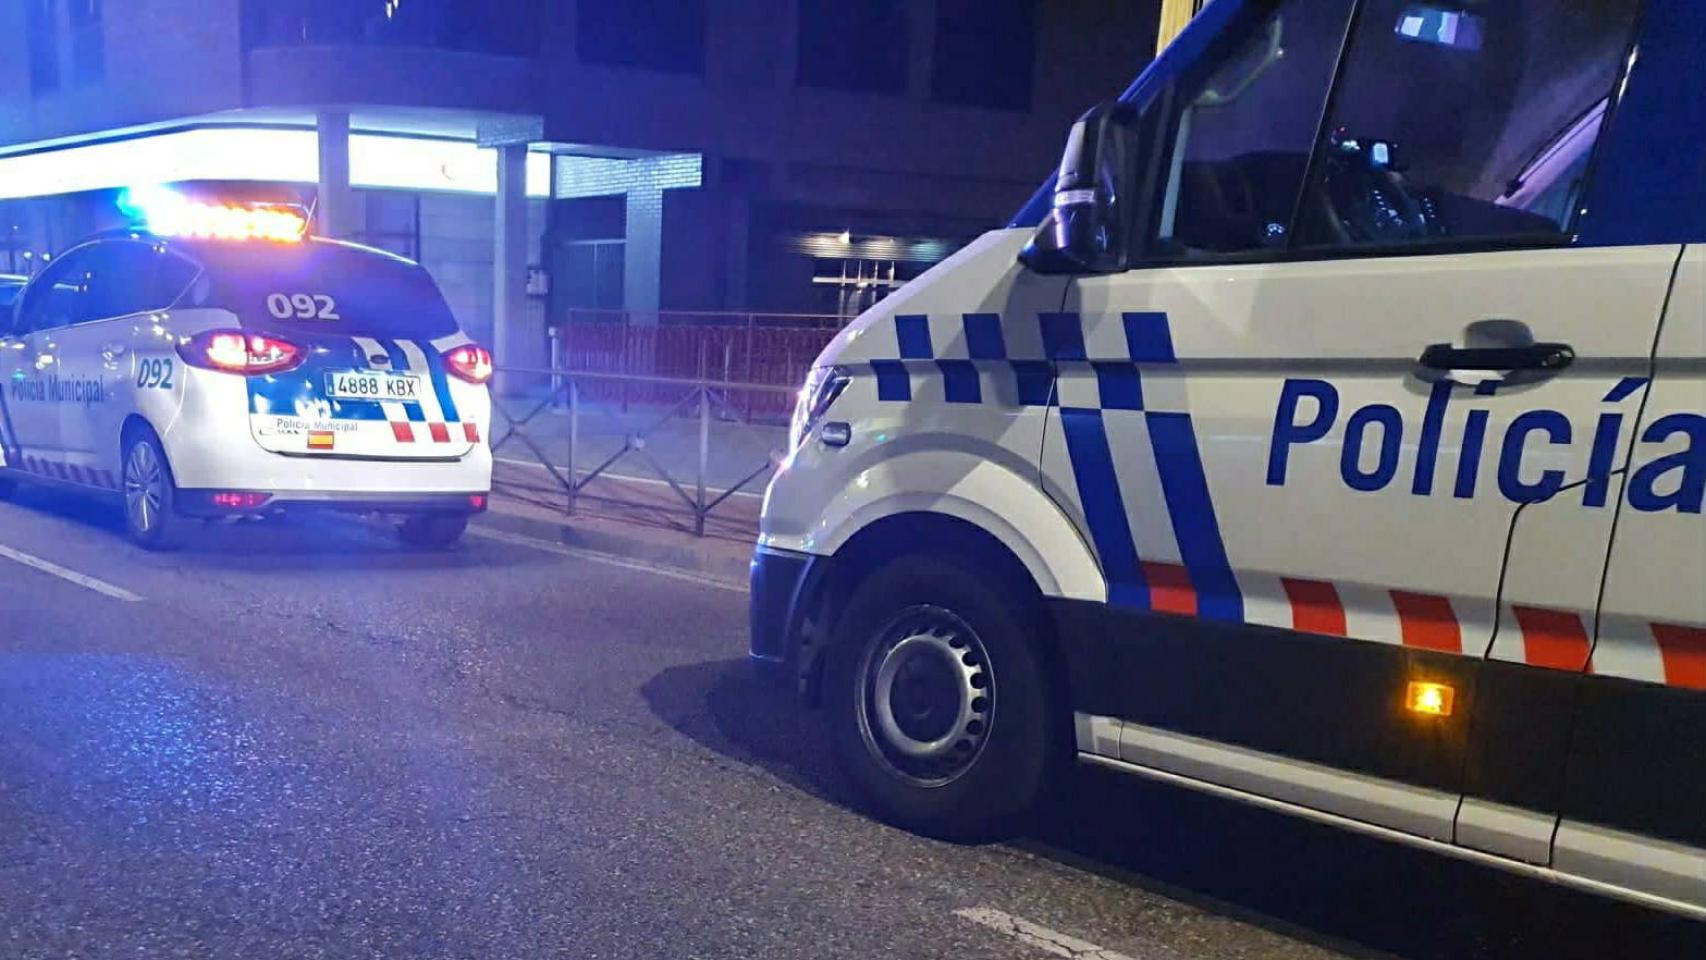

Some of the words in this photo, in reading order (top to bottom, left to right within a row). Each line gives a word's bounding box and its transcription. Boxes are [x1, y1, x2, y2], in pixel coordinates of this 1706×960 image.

[267, 293, 340, 320] 092
[137, 358, 173, 389] 092
[338, 376, 378, 394] 4888
[386, 380, 415, 396] KBX
[49, 374, 104, 408] Municipal
[313, 421, 358, 432] Municipal
[1266, 377, 1706, 514] Policía
